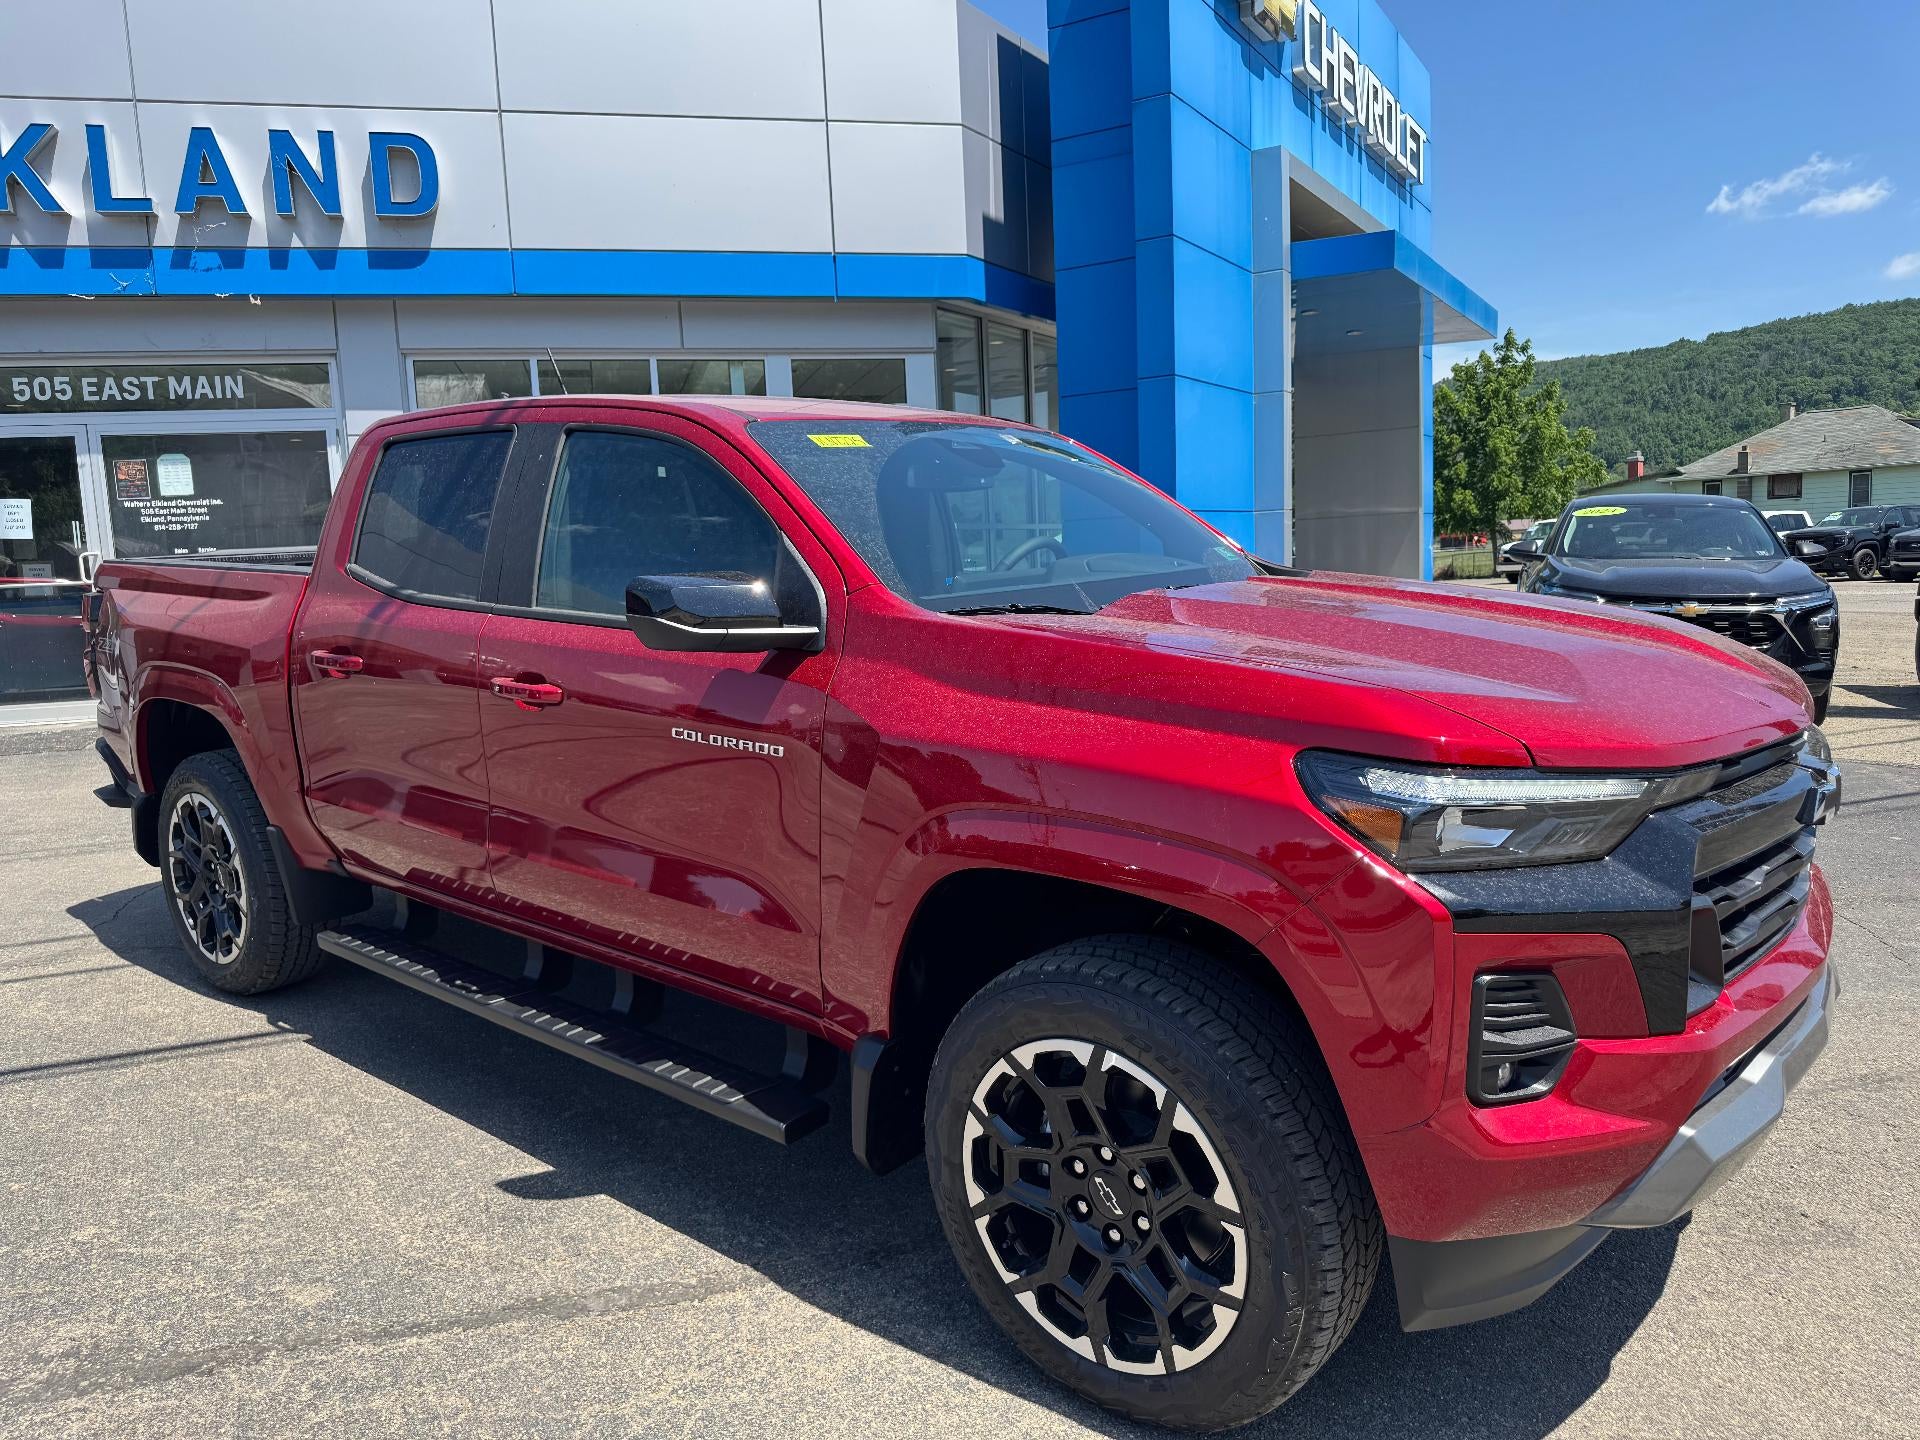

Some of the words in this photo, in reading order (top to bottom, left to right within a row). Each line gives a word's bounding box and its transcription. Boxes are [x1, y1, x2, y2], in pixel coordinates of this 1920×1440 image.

[1298, 0, 1428, 186] CHEVROLET
[0, 123, 440, 219] KLAND
[12, 376, 73, 402] 505
[82, 375, 160, 402] EAST
[167, 375, 245, 400] MAIN
[151, 499, 176, 507] Elkland
[155, 507, 170, 515] East
[187, 506, 208, 514] Street
[167, 515, 210, 524] Pennsylvania
[671, 727, 785, 758] COLORADO
